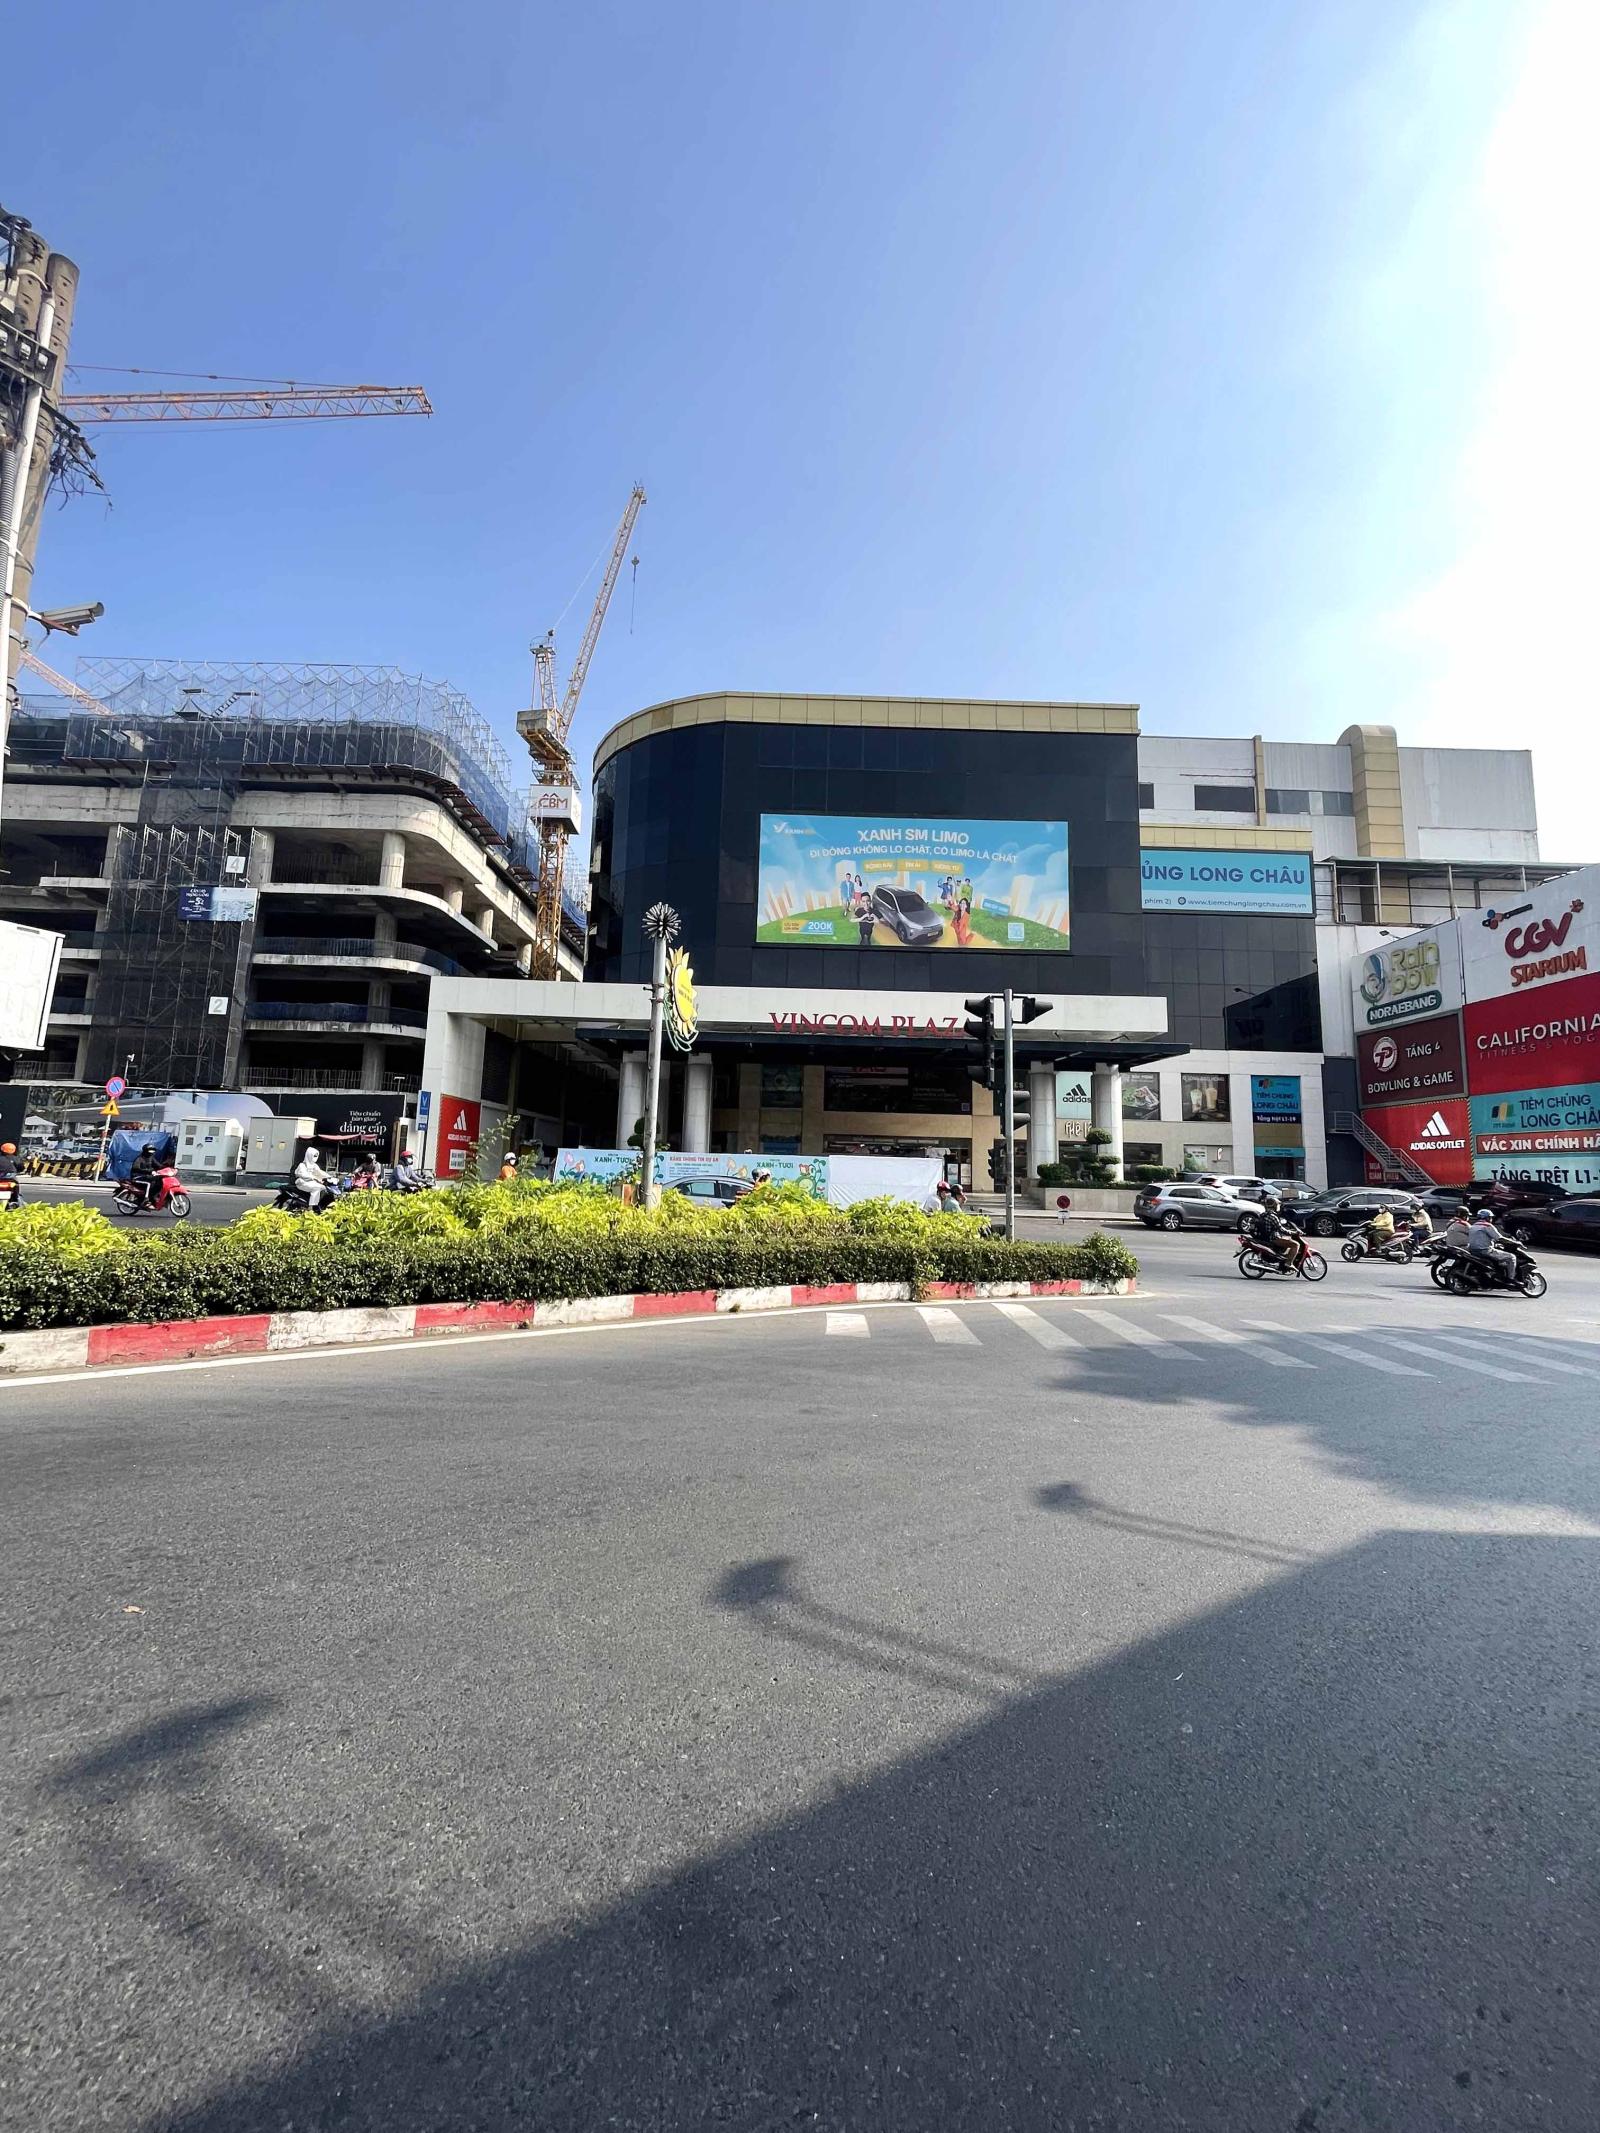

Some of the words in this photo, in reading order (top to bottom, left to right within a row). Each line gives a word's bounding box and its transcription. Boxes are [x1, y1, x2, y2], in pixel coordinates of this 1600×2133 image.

[858, 828, 902, 842] XANH
[905, 828, 928, 841] SM
[931, 830, 969, 845] LIMO
[950, 847, 975, 858] LIMO
[230, 857, 241, 872] 4
[1190, 866, 1243, 883] LONG
[1250, 865, 1305, 885] CHÂU
[808, 921, 833, 930] 200K
[1505, 912, 1573, 958] CGV
[1511, 945, 1587, 987] STARIUM
[213, 998, 223, 1013] 2
[1369, 994, 1437, 1021] NORAEBANG
[768, 1012, 881, 1035] VINCOM
[891, 1015, 966, 1037] PLAZ
[1477, 1013, 1600, 1050] CALIFORNIA
[1367, 1077, 1411, 1094] BOWLING
[1413, 1076, 1421, 1087] &
[1423, 1071, 1454, 1086] GAME
[1519, 1096, 1545, 1110] TIÊM
[1521, 1112, 1561, 1128] LONG
[1564, 1106, 1600, 1126] CHÂ
[1409, 1142, 1436, 1151] ADIDAS
[1436, 1139, 1465, 1150] OUTLET
[1482, 1135, 1508, 1152] VẮC
[1510, 1139, 1532, 1150] XIN
[1535, 1135, 1580, 1150] CHÍNH
[1490, 1163, 1531, 1181] TẦNG
